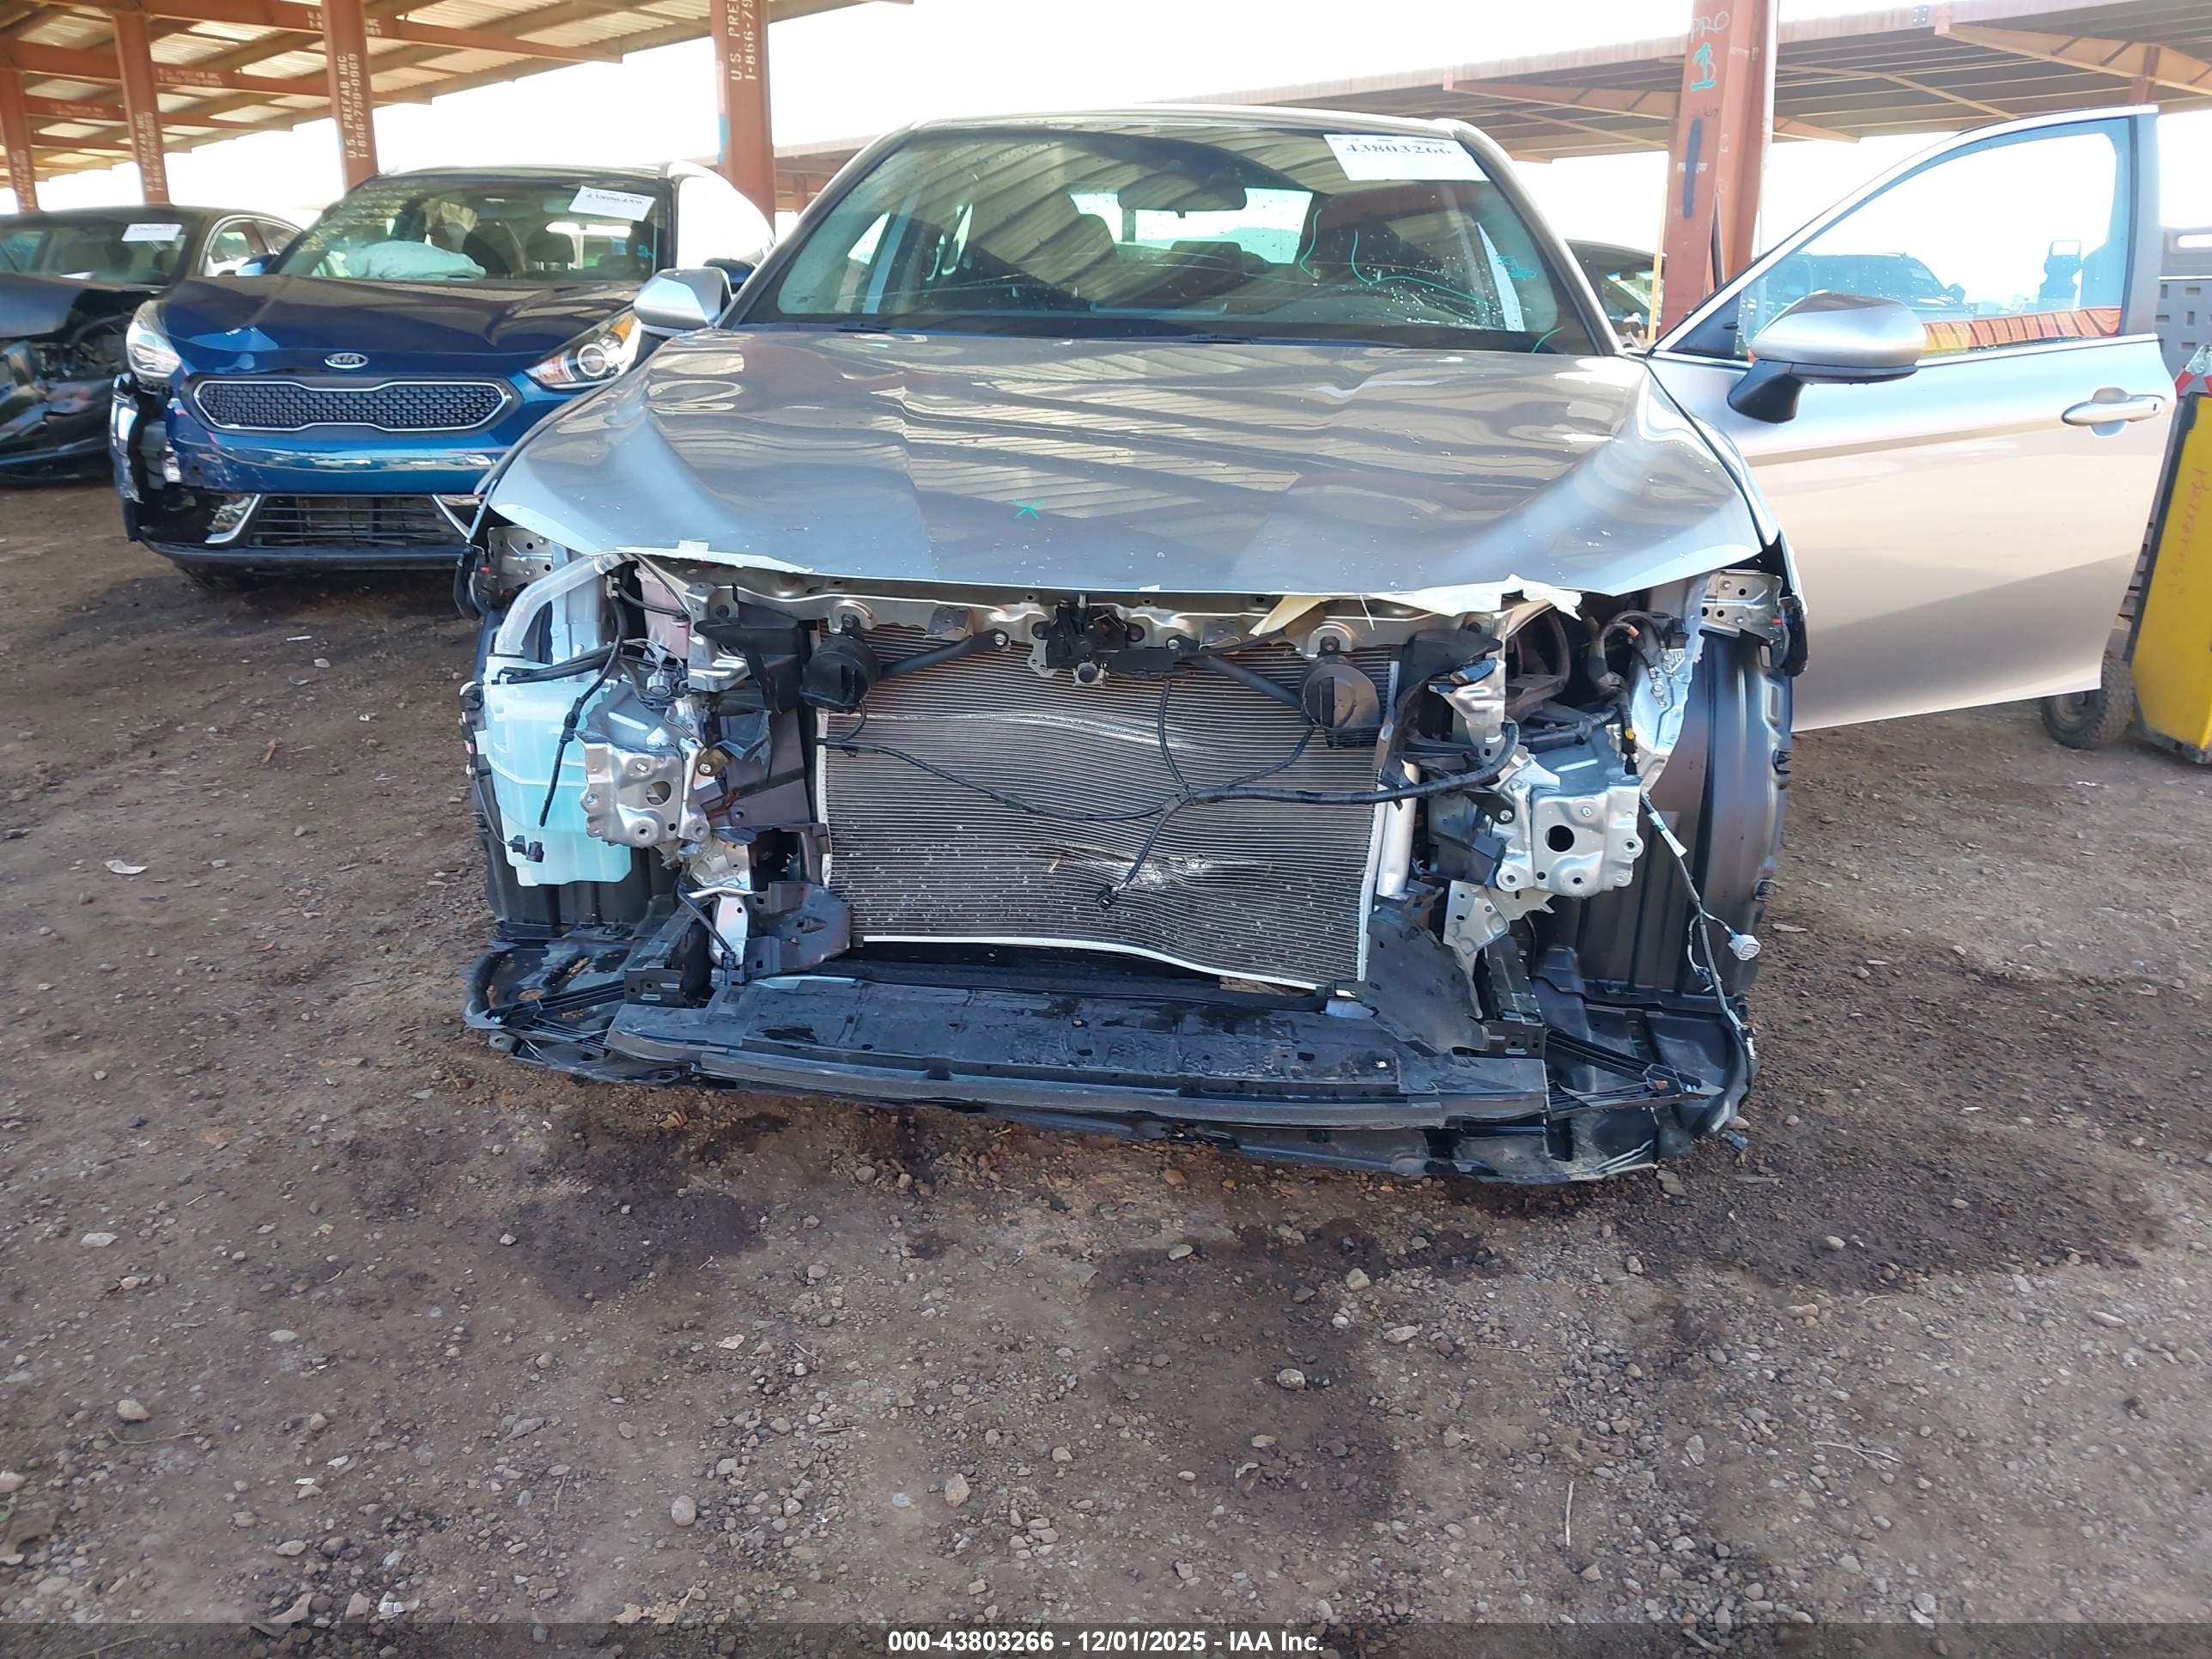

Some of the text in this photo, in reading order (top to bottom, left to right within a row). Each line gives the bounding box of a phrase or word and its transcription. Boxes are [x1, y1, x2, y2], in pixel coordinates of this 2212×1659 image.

[726, 0, 742, 80] U.S. PRE
[1690, 10, 1730, 43] PRO
[337, 52, 357, 158] U.S. PREFAB INC.
[1346, 143, 1452, 155] 43803266
